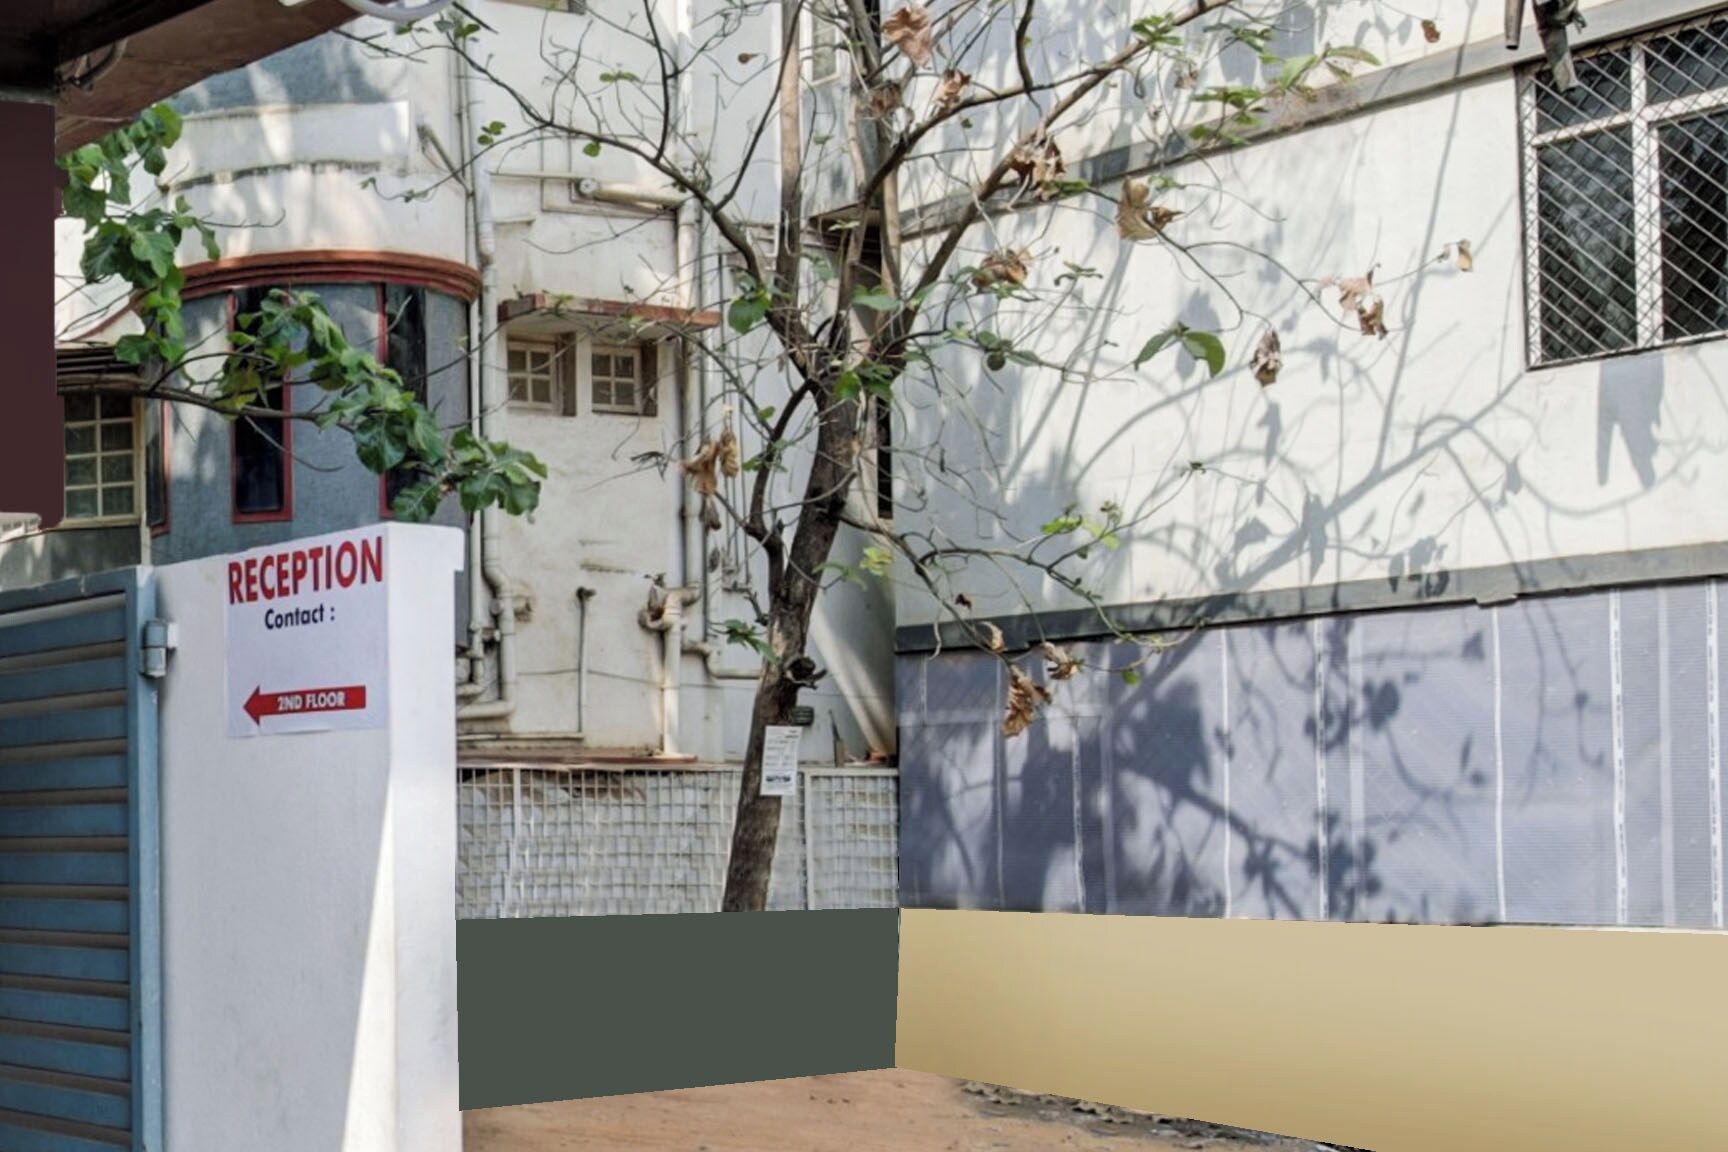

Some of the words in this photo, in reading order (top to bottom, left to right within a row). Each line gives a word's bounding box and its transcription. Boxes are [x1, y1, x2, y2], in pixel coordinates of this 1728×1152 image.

[228, 536, 383, 604] RECEPTION
[264, 604, 325, 629] Contact
[277, 694, 303, 711] 2ND
[305, 691, 346, 708] FLOOR
